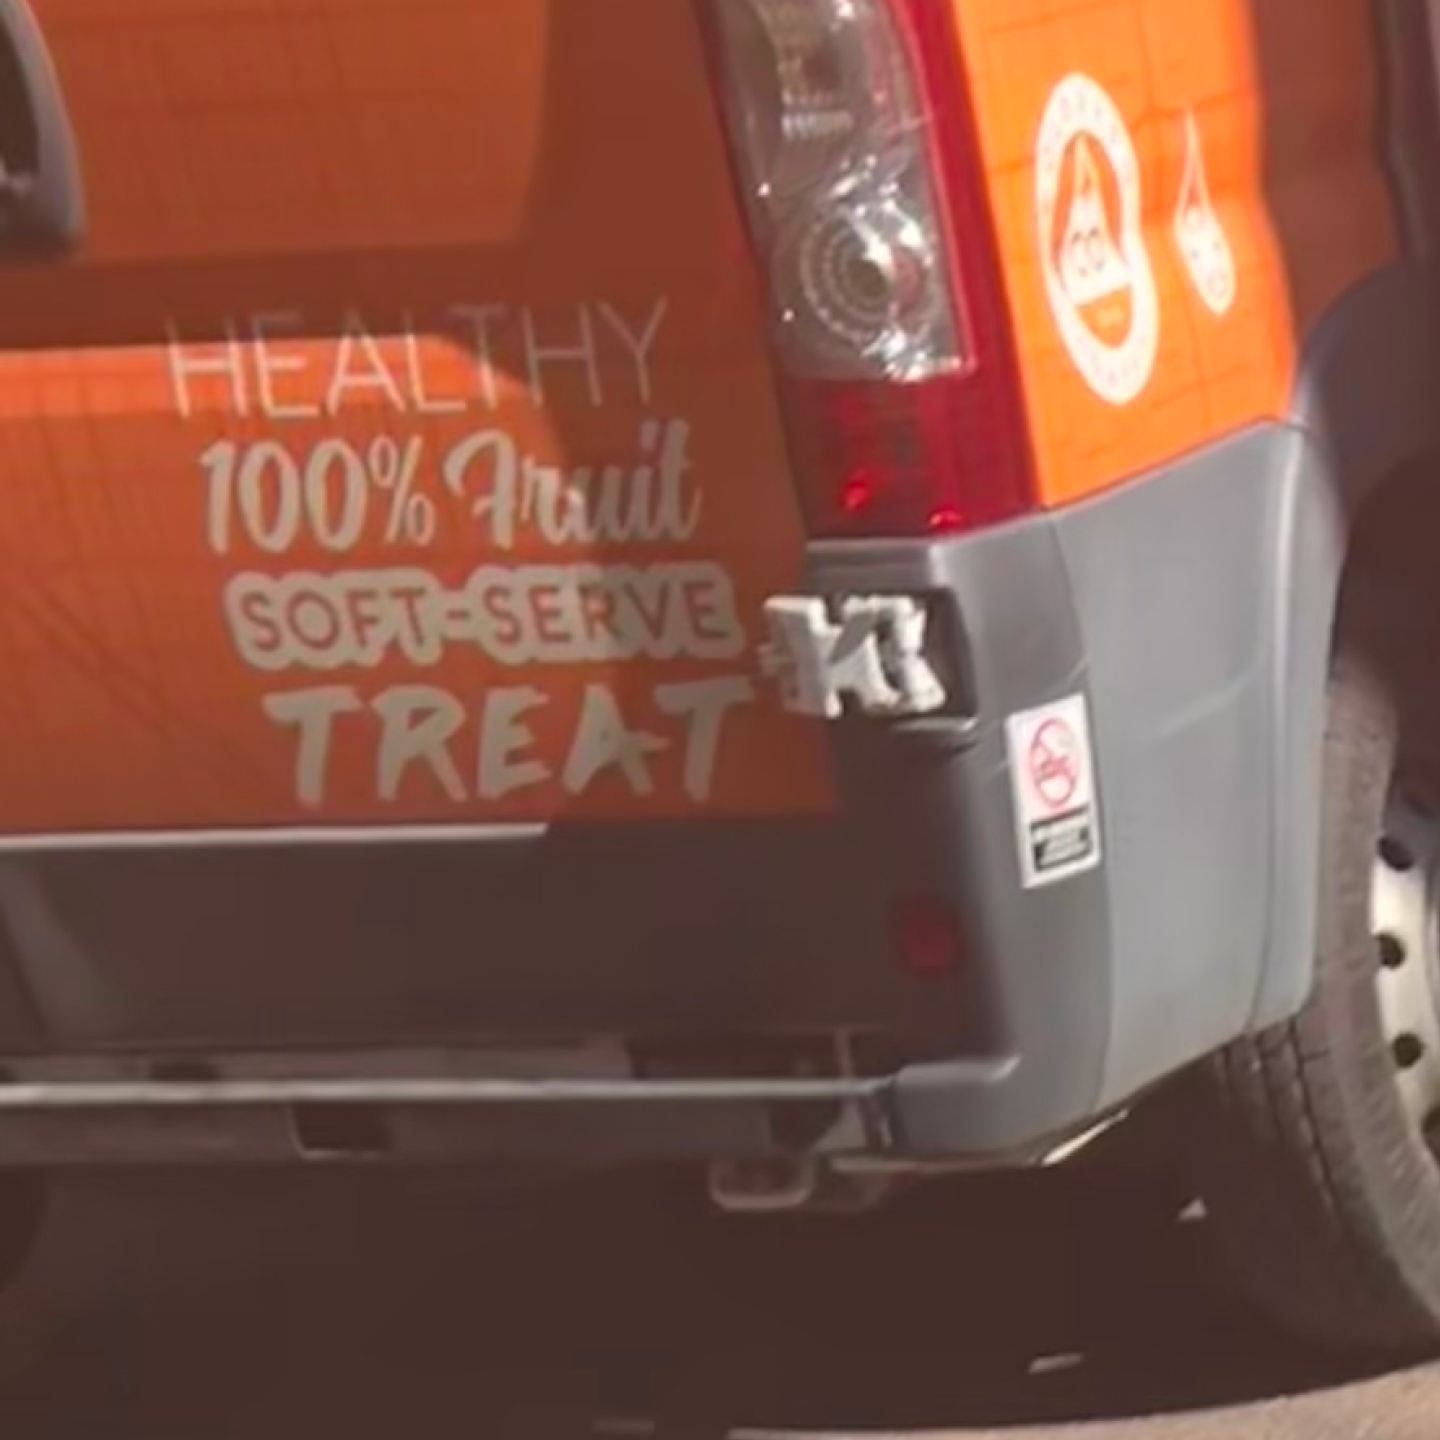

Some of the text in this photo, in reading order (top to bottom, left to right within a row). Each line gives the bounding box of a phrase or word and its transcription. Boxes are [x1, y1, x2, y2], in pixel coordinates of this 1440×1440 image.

[166, 297, 667, 419] HEALTHY
[200, 420, 702, 554] 100% Fruit
[241, 576, 730, 655] SOFT-SERVE
[262, 676, 754, 806] TREAT
